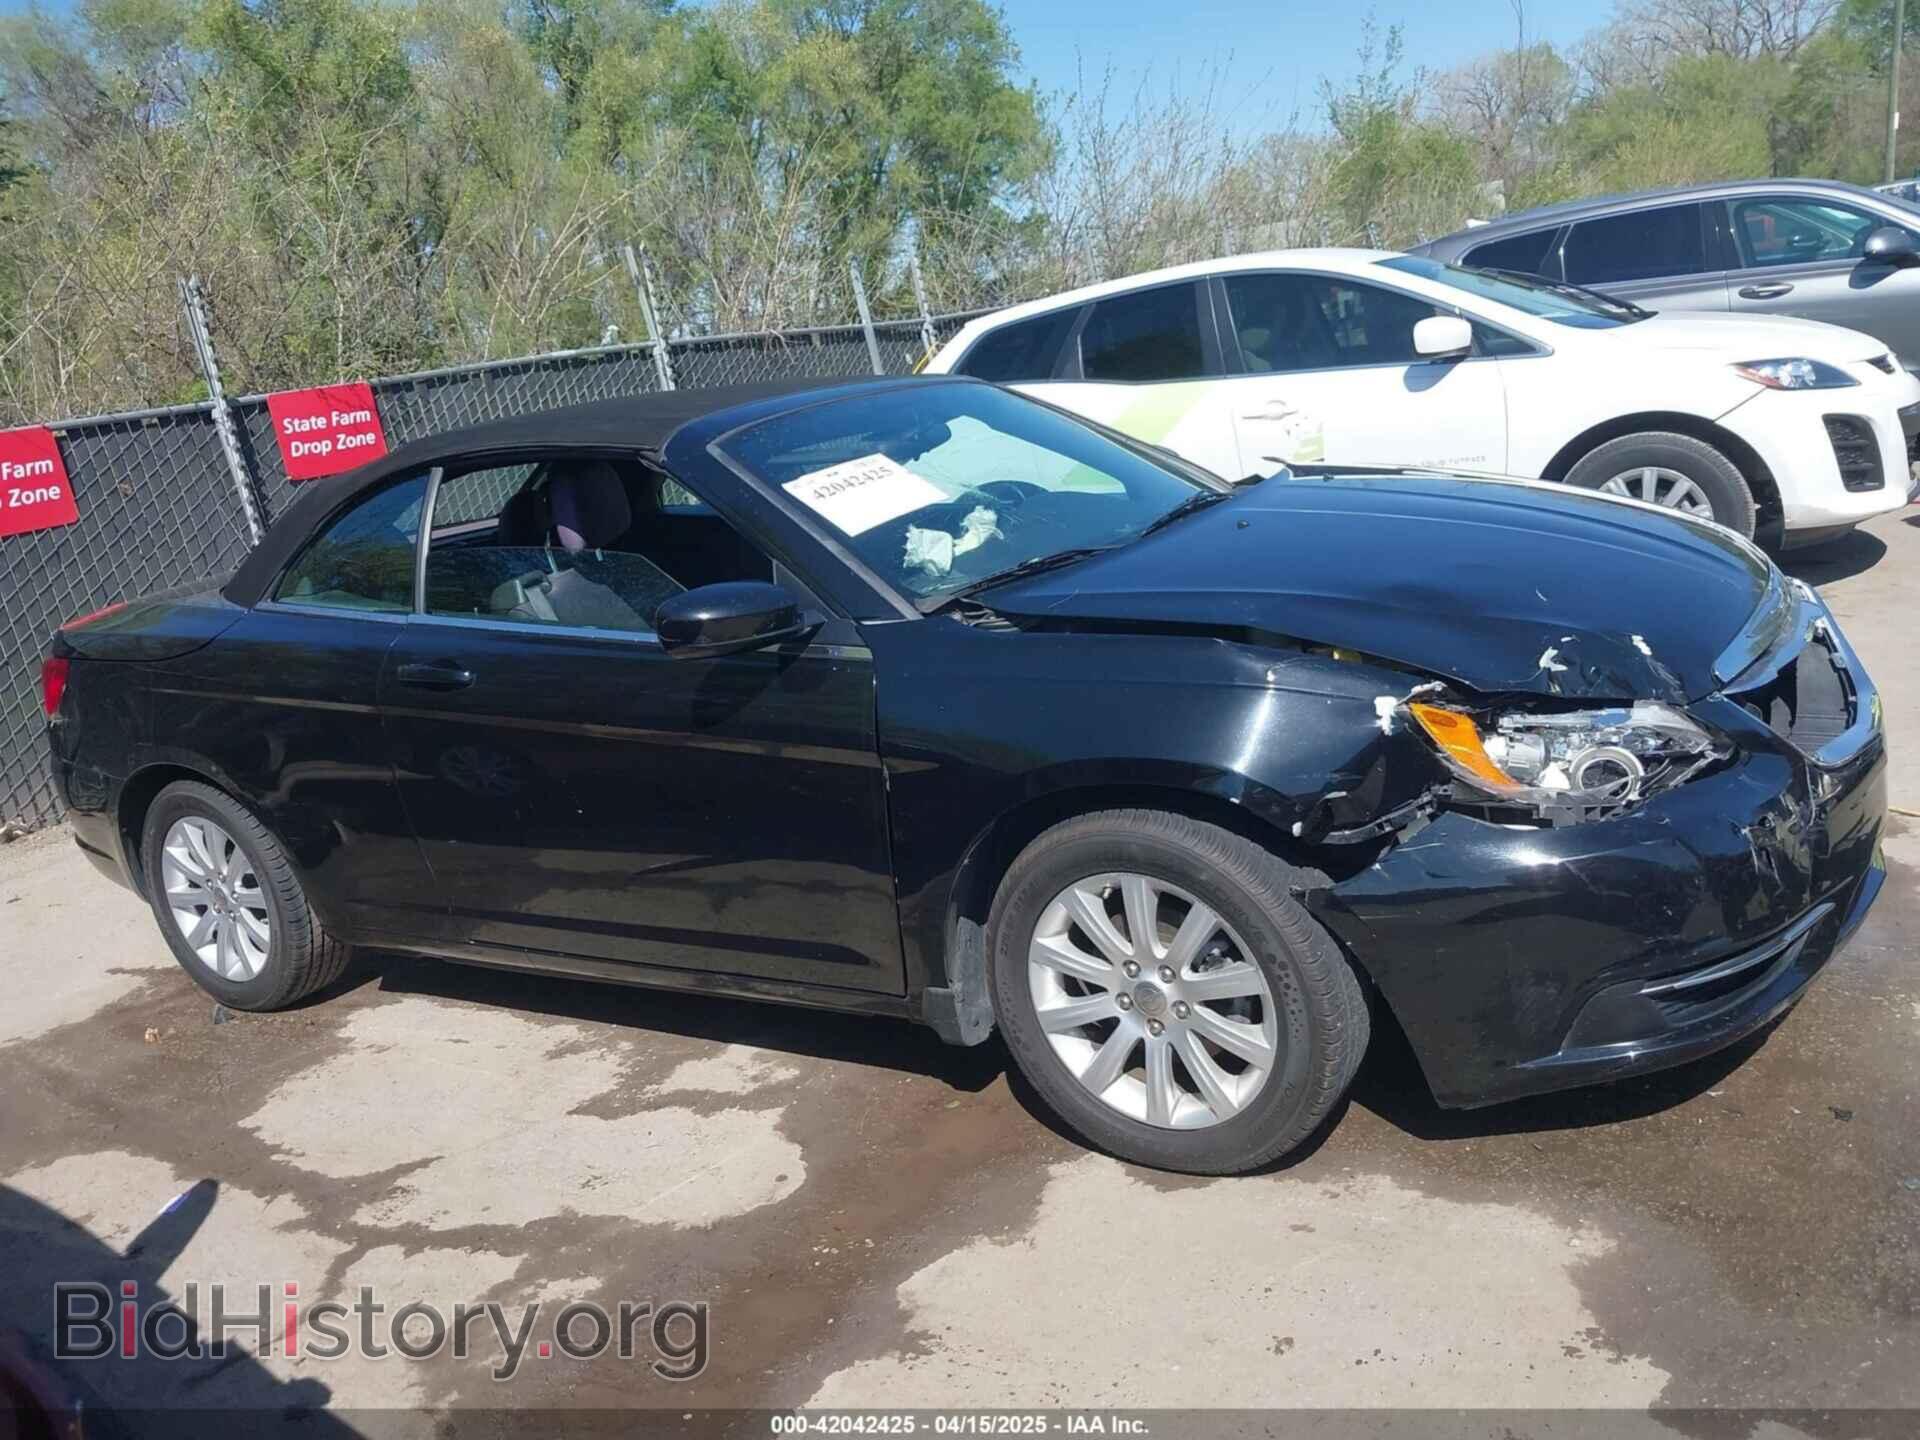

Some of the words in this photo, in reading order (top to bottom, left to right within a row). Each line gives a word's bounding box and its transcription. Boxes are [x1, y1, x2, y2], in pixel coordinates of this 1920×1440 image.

[282, 414, 328, 436] State
[331, 409, 372, 429] Farm
[290, 439, 332, 459] Drop
[336, 432, 376, 450] Zone
[1, 459, 54, 481] Farm
[812, 466, 895, 500] 42042425
[7, 486, 61, 508] Zone
